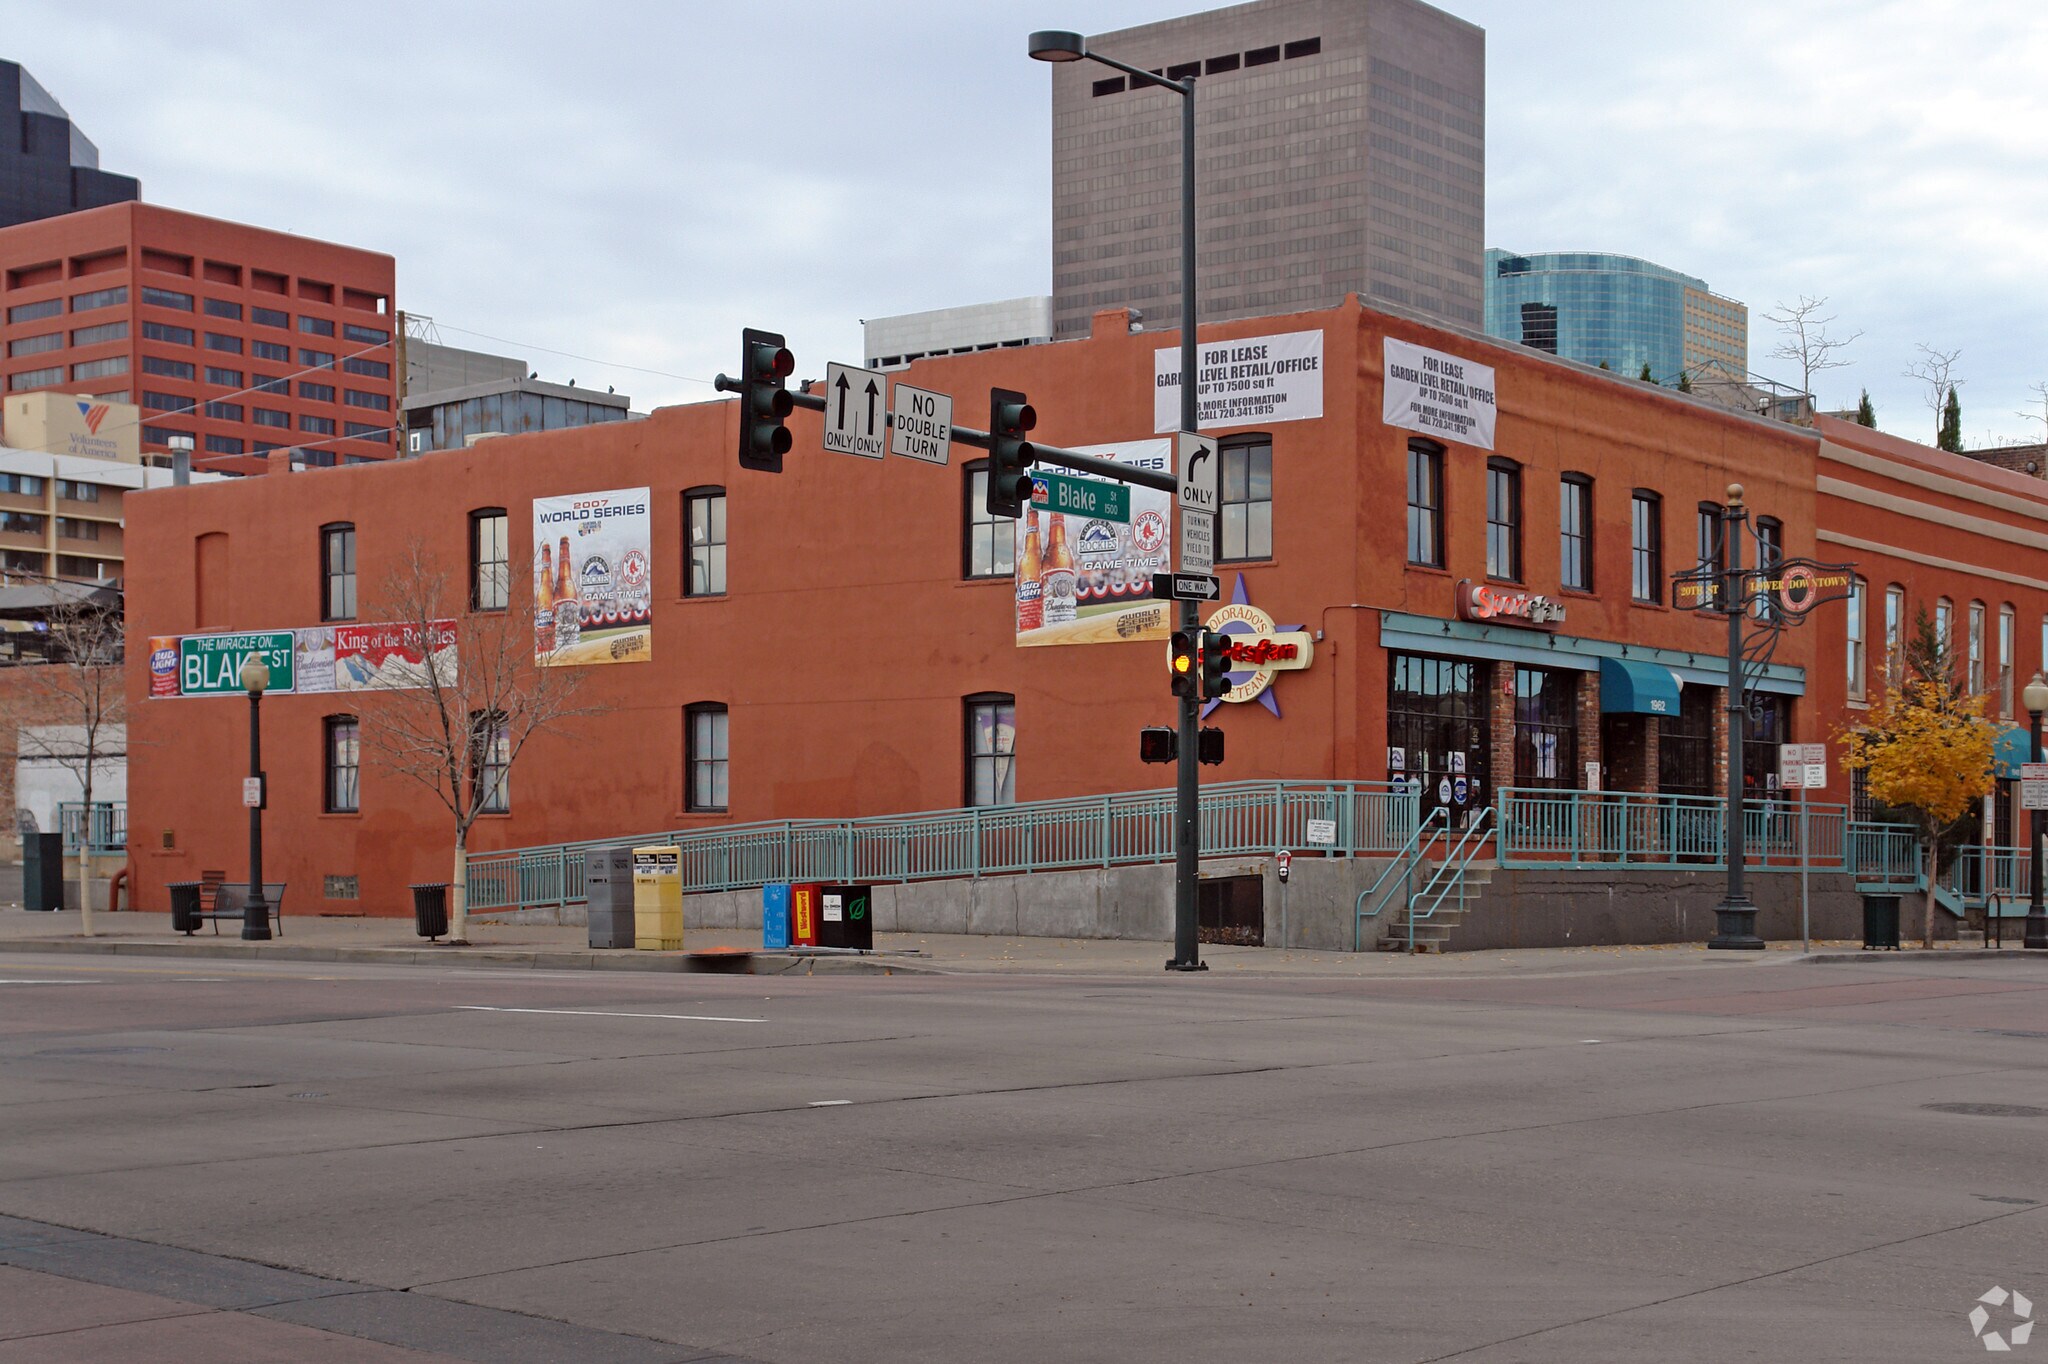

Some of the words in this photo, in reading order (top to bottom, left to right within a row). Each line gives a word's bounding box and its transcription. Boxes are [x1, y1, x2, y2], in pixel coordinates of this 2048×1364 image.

[1205, 350, 1228, 366] FOR
[1232, 345, 1268, 362] LEASE
[1200, 366, 1228, 382] LEVEL
[1231, 356, 1318, 378] RETAIL/OFFICE
[1423, 356, 1439, 373] FOR
[1441, 360, 1463, 380] LEASE
[1198, 383, 1211, 394] UP
[1214, 382, 1225, 393] TO
[1227, 380, 1250, 391] 7500
[1253, 380, 1264, 389] sq
[1267, 377, 1274, 387] ft
[1391, 364, 1419, 384] GARDEN
[1420, 372, 1439, 390] LEVEL
[1441, 378, 1494, 405] RETAIL/OFFICE
[1203, 399, 1227, 410] MORE
[1229, 393, 1287, 408] INFORMATION
[1420, 387, 1428, 398] UP
[1429, 390, 1437, 401] TO
[1438, 392, 1453, 406] 7500
[912, 394, 935, 417] NO
[1198, 410, 1217, 421] CALL
[1220, 404, 1274, 420] 720.341.1815
[1410, 402, 1421, 413] FOR
[1423, 404, 1438, 417] MORE
[1439, 409, 1476, 427] INFORMATION
[1419, 414, 1431, 426] CALL
[898, 415, 946, 440] DOUBLE
[70, 433, 117, 448] Volunteers
[827, 432, 853, 449] ONLY
[857, 437, 882, 454] ONLY
[905, 436, 938, 458] TURN
[69, 444, 77, 453] of
[80, 445, 117, 458] America
[1059, 482, 1096, 511] Blake
[1110, 491, 1117, 501] St
[1184, 487, 1213, 504] ONLY
[573, 500, 609, 510] 2007
[1104, 504, 1118, 515] 1500
[540, 509, 589, 523] WORLD
[594, 504, 645, 518] SERIES
[1137, 513, 1161, 527] BOSTON
[1187, 515, 1209, 528] TURNING
[1186, 529, 1210, 542] VEHICLES
[1080, 539, 1117, 550] ROCKIES
[1186, 543, 1201, 553] YIELD
[1203, 545, 1210, 555] TO
[1084, 560, 1123, 571] GAME
[1126, 557, 1158, 568] TIME
[1183, 555, 1213, 568] PEDESTRIANS
[1020, 582, 1040, 590] BUD
[1178, 580, 1192, 591] ONE
[1194, 581, 1208, 592] WAY
[1680, 586, 1703, 596] 20TH
[1707, 584, 1719, 595] ST
[1750, 581, 1784, 592] LOWER
[1789, 576, 1848, 589] DOWNTOWN
[585, 592, 614, 600] GAME
[617, 590, 641, 598] TIME
[1125, 609, 1160, 620] WORLD
[1209, 607, 1267, 633] OLORADO'S
[196, 639, 214, 651] THE
[216, 637, 256, 650] MIRACLE
[258, 636, 279, 648] ON...
[337, 631, 369, 653] King
[371, 633, 383, 647] of
[384, 632, 399, 647] the
[154, 650, 175, 661] BUD
[272, 649, 290, 668] ST
[152, 658, 178, 670] LIGHT
[1237, 672, 1267, 699] TEAM
[1651, 699, 1666, 711] 1962
[799, 892, 808, 930] Westword
